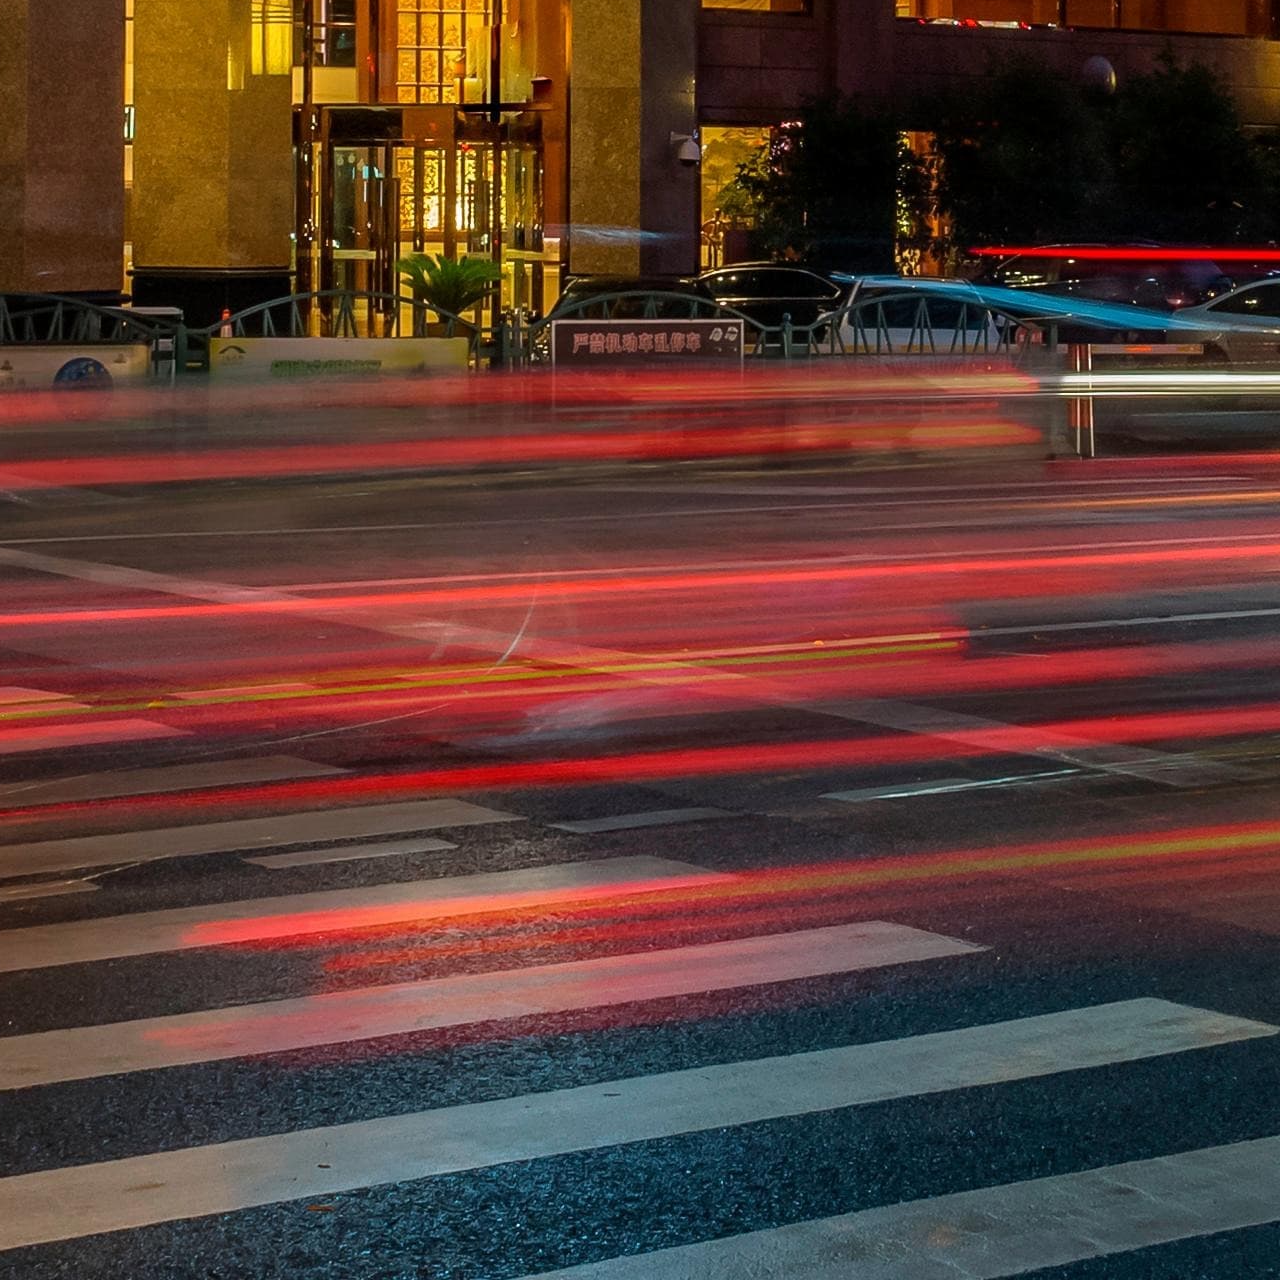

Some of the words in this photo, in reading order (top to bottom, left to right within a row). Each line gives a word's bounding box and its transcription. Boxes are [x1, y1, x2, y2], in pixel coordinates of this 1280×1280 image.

[572, 332, 701, 354] 严禁机动车乱停车
